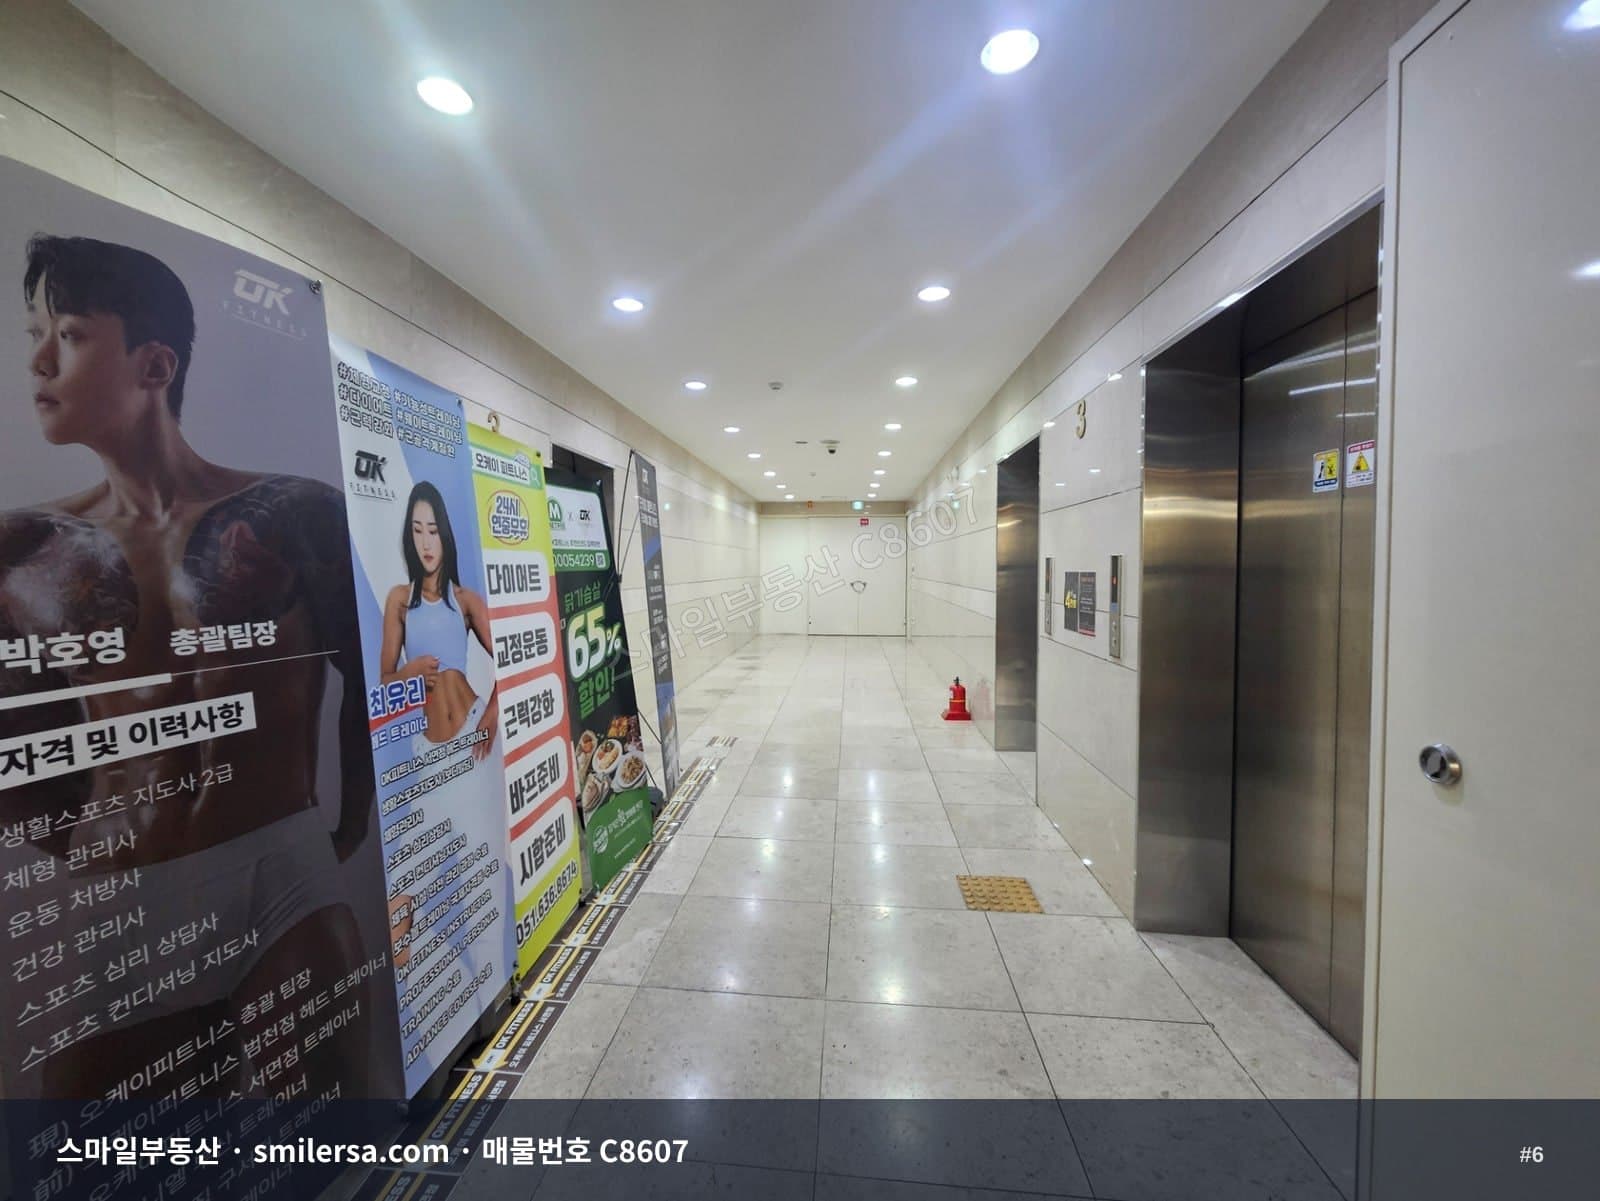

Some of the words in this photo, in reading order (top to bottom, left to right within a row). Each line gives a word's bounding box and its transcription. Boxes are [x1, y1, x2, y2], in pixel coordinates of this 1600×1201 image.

[339, 383, 393, 419] #다이어트
[1075, 400, 1087, 439] 3
[354, 450, 387, 482] OK
[475, 452, 499, 472] 오케이
[500, 460, 528, 481] 피트니스
[491, 514, 529, 538] 연중무휴
[495, 495, 521, 516] 24시
[486, 563, 542, 595] 다이어트
[0, 627, 126, 674] 박호영
[169, 620, 278, 656] 총괄팀장
[495, 627, 549, 668] 교정운동
[567, 601, 621, 680] 65%
[370, 675, 426, 718] 최유리
[503, 688, 555, 740] 근력강화
[578, 664, 616, 720] 할인!
[0, 735, 76, 777] 자격
[87, 724, 119, 758] 및
[129, 700, 245, 747] 이력사항
[390, 716, 428, 739] 트레이너
[0, 794, 128, 849] 생활스포츠
[133, 774, 199, 806] 지도사
[202, 762, 234, 786] 2급
[509, 752, 560, 815] 바프준비
[3, 856, 57, 891] 체형
[66, 829, 139, 870] 관리사
[387, 843, 412, 873] 스포츠
[520, 814, 566, 886] 시험준비
[8, 899, 63, 939] 운동
[70, 868, 143, 911] 처방사
[389, 870, 415, 901] 스포츠
[12, 941, 66, 983] 건강
[74, 906, 147, 954] 관리사
[396, 961, 412, 984] OK
[410, 929, 448, 970] FITNESS
[446, 888, 493, 938] INSTRUCTOR
[399, 942, 463, 1013] PROFESSIONAL
[462, 906, 499, 950] PERSONAL
[17, 972, 97, 1027] 스포츠
[103, 944, 151, 983] 심리
[157, 911, 219, 956] 상담사
[300, 991, 331, 1020] 헤드
[333, 952, 387, 999] 트레이너
[20, 1013, 101, 1073] 스포츠
[107, 960, 198, 1022] 컨디셔닝
[202, 928, 259, 970] 지도사
[402, 986, 446, 1039] TRAINING
[406, 1010, 449, 1069] ADVANCE
[448, 977, 480, 1018] COURSE
[496, 1035, 510, 1049] OK
[507, 1003, 534, 1038] FITNESS
[79, 1017, 236, 1128] 오케이피트니스
[240, 990, 275, 1025] 총괄
[279, 967, 312, 1000] 팀장
[248, 1045, 299, 1092] 서면점
[304, 1000, 360, 1054] 트레이너
[240, 1073, 308, 1138] 트레이너
[279, 1082, 341, 1143] 트레이너
[431, 1119, 451, 1139] OK
[445, 1075, 483, 1119] FITNESS
